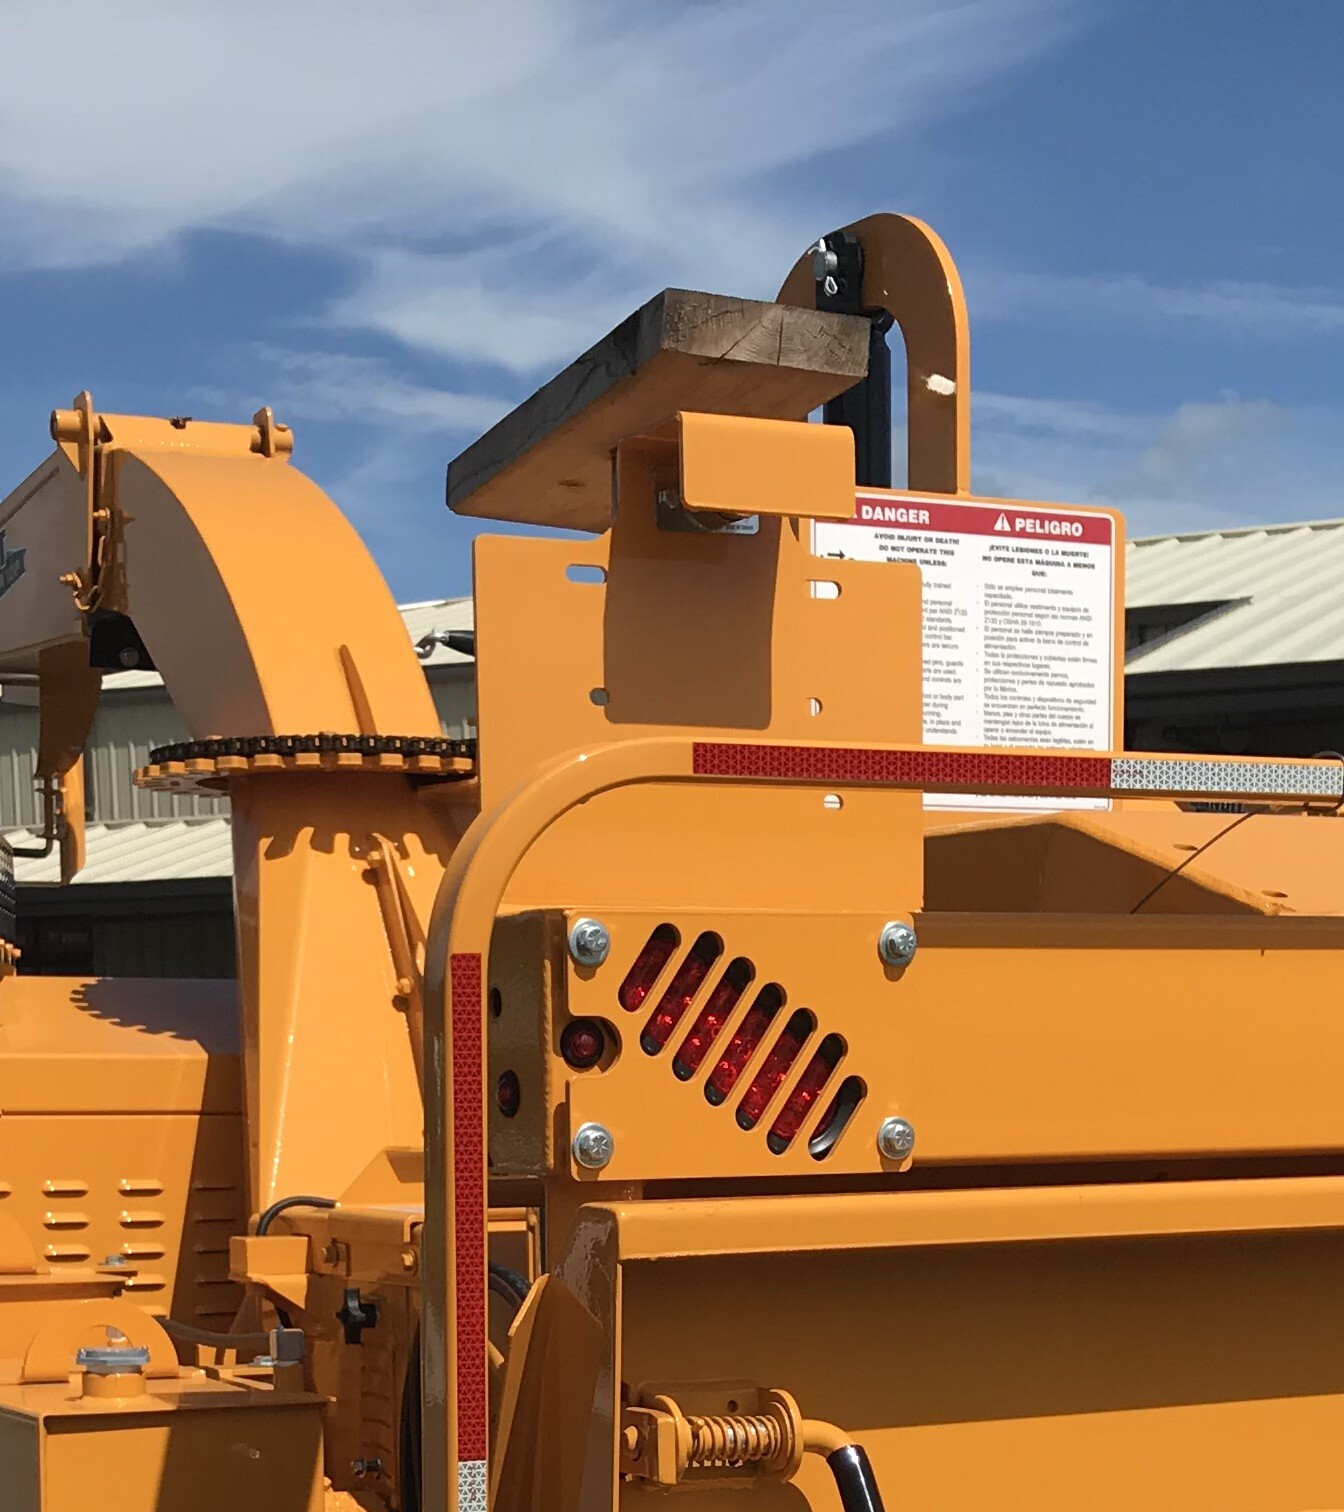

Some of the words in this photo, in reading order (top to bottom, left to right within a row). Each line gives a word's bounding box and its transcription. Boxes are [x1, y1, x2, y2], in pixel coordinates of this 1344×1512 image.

[861, 505, 930, 525] DANGER
[1015, 517, 1083, 537] PELIGRO
[907, 547, 937, 555] OPERATE
